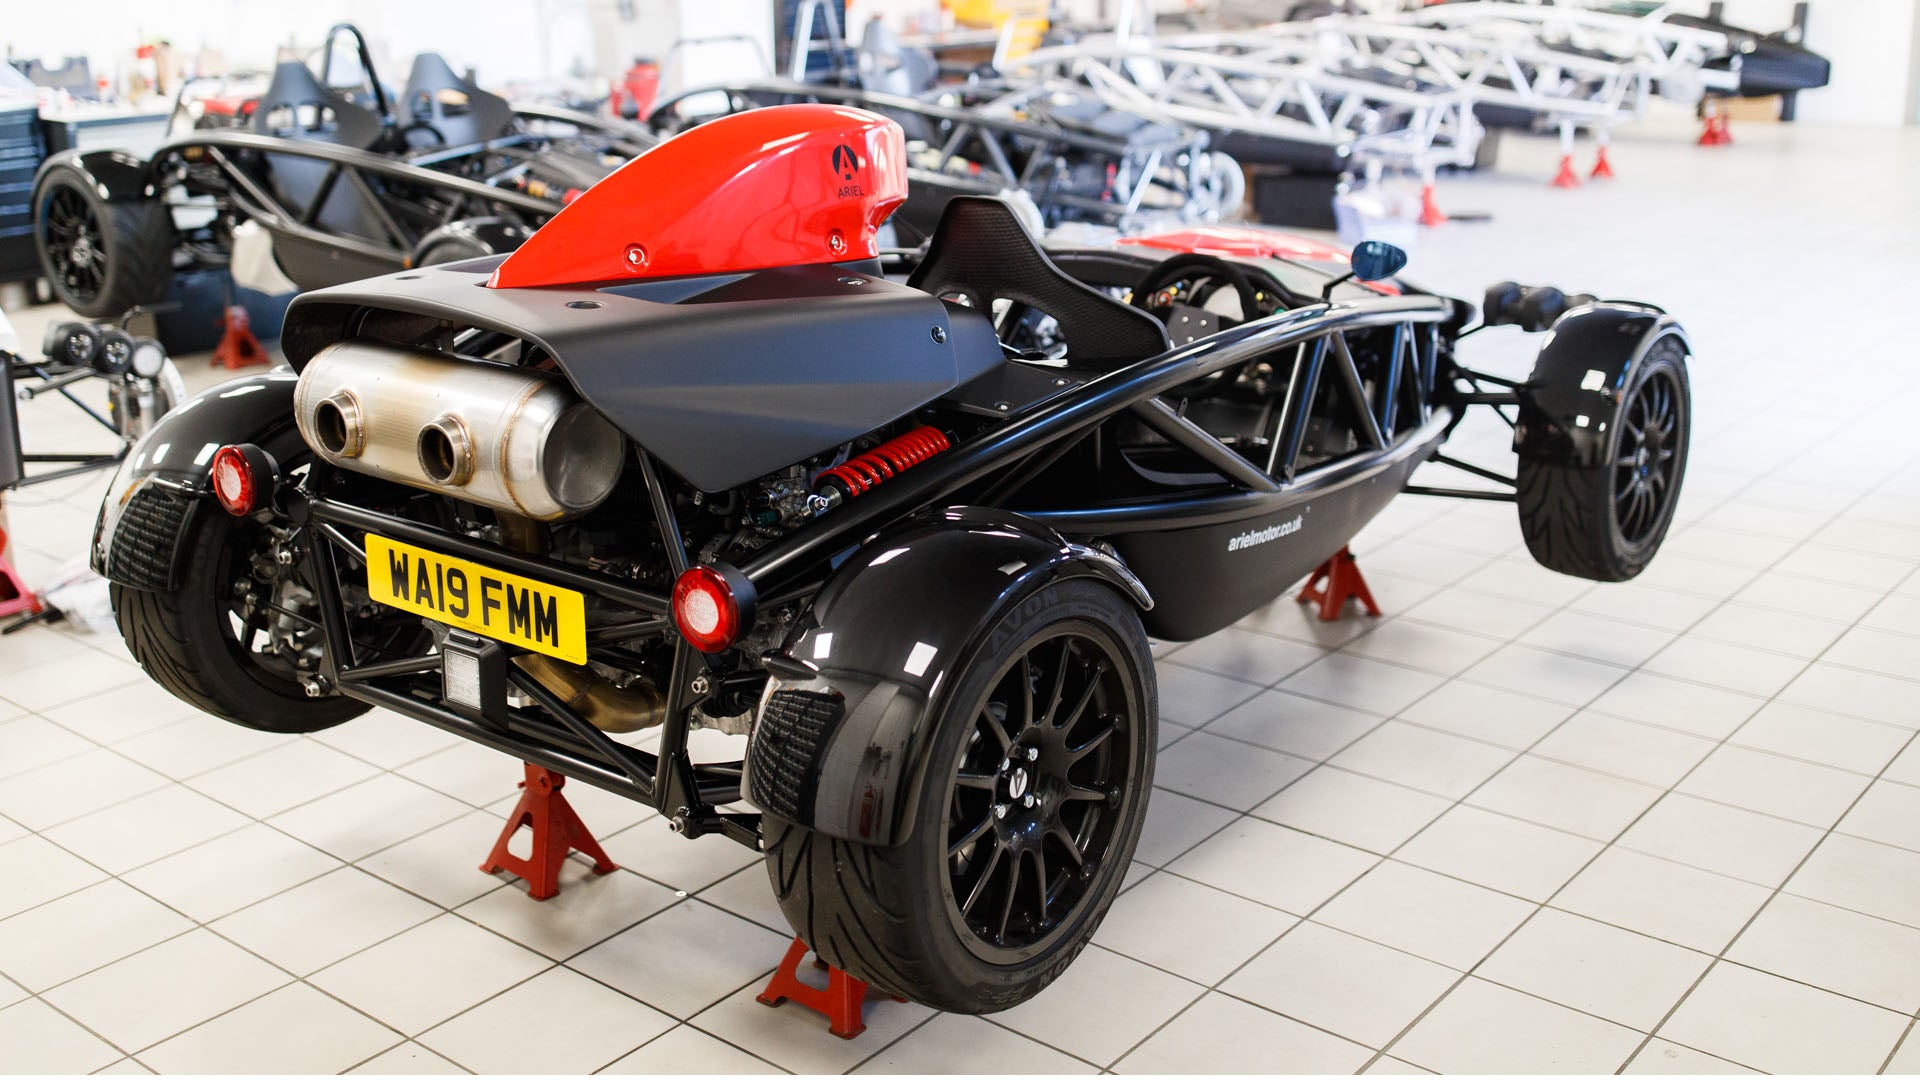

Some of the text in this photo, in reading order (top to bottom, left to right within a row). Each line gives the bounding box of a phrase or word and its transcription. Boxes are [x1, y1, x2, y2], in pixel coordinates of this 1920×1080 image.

[838, 185, 864, 198] ARIEL
[1228, 514, 1303, 551] arielmotor.co.uk
[388, 549, 559, 648] WA19 FMM
[991, 588, 1059, 655] AVON
